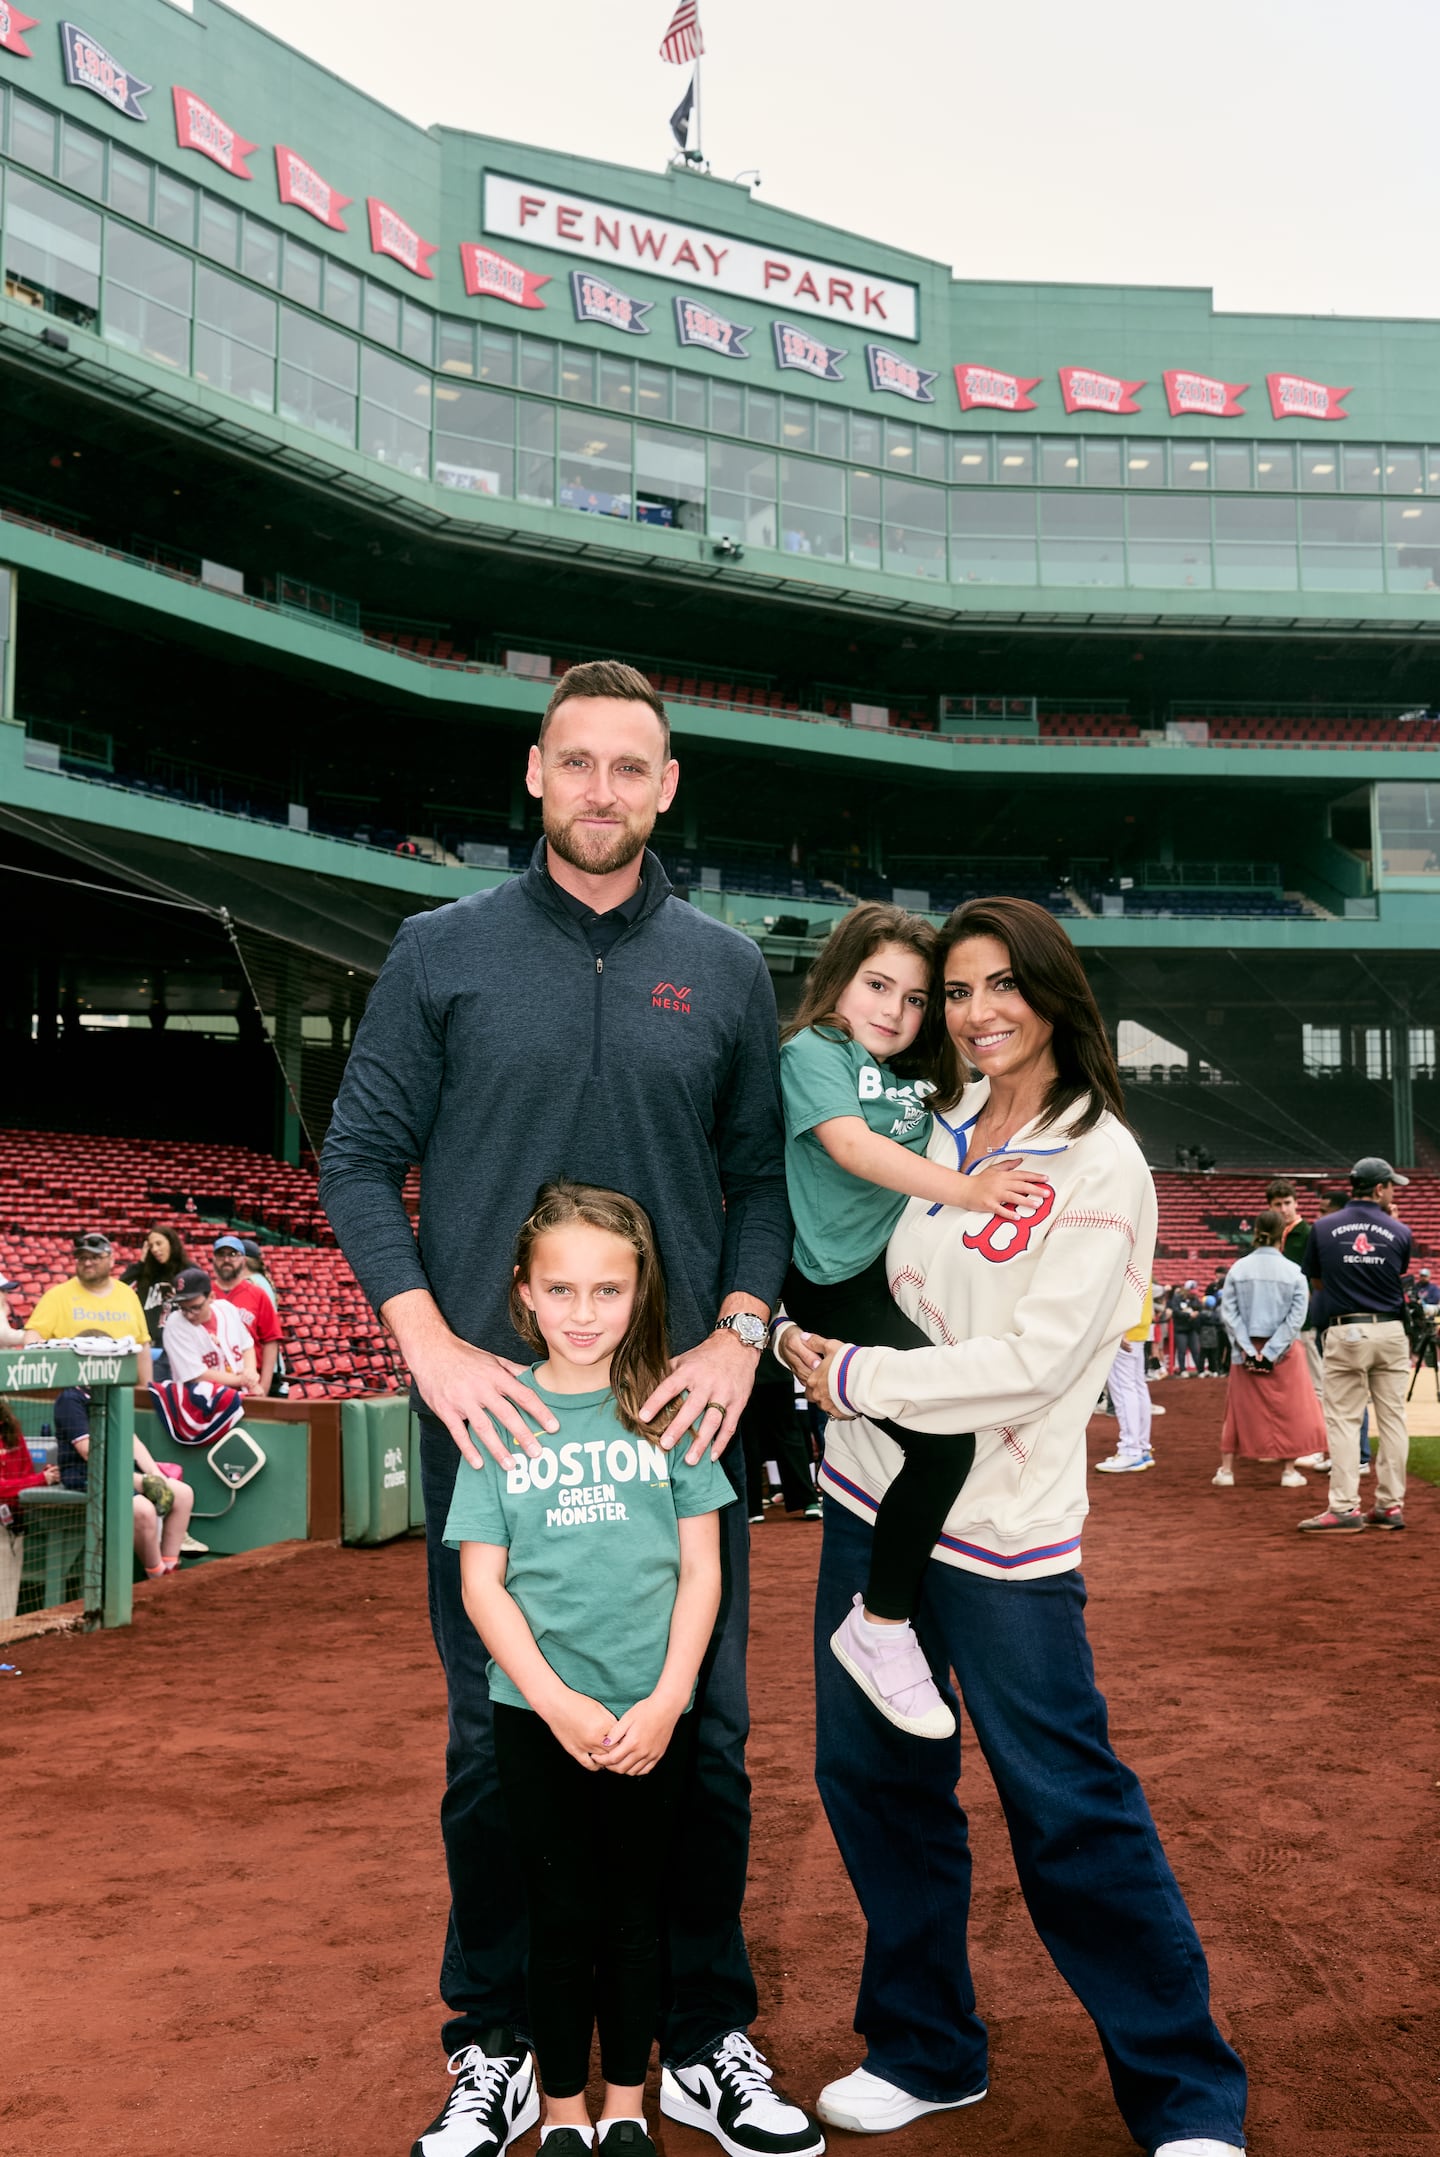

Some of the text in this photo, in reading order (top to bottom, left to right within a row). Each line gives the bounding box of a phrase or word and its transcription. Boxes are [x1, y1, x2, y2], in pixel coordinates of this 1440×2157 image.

[519, 195, 888, 320] FENWAY PARK
[476, 257, 525, 294] 1918
[965, 375, 1018, 401] 2004
[1070, 378, 1123, 403] 2007
[1175, 380, 1226, 405] 2013
[1278, 384, 1329, 409] 2018
[652, 996, 691, 1015] NESN
[1331, 1223, 1395, 1241] FENWAY PARK
[1342, 1254, 1386, 1265] SECURITY
[6, 1355, 58, 1391] xfinity
[78, 1355, 122, 1386] xfinity
[507, 1439, 669, 1494] BOSTON
[558, 1484, 616, 1507] GREEN
